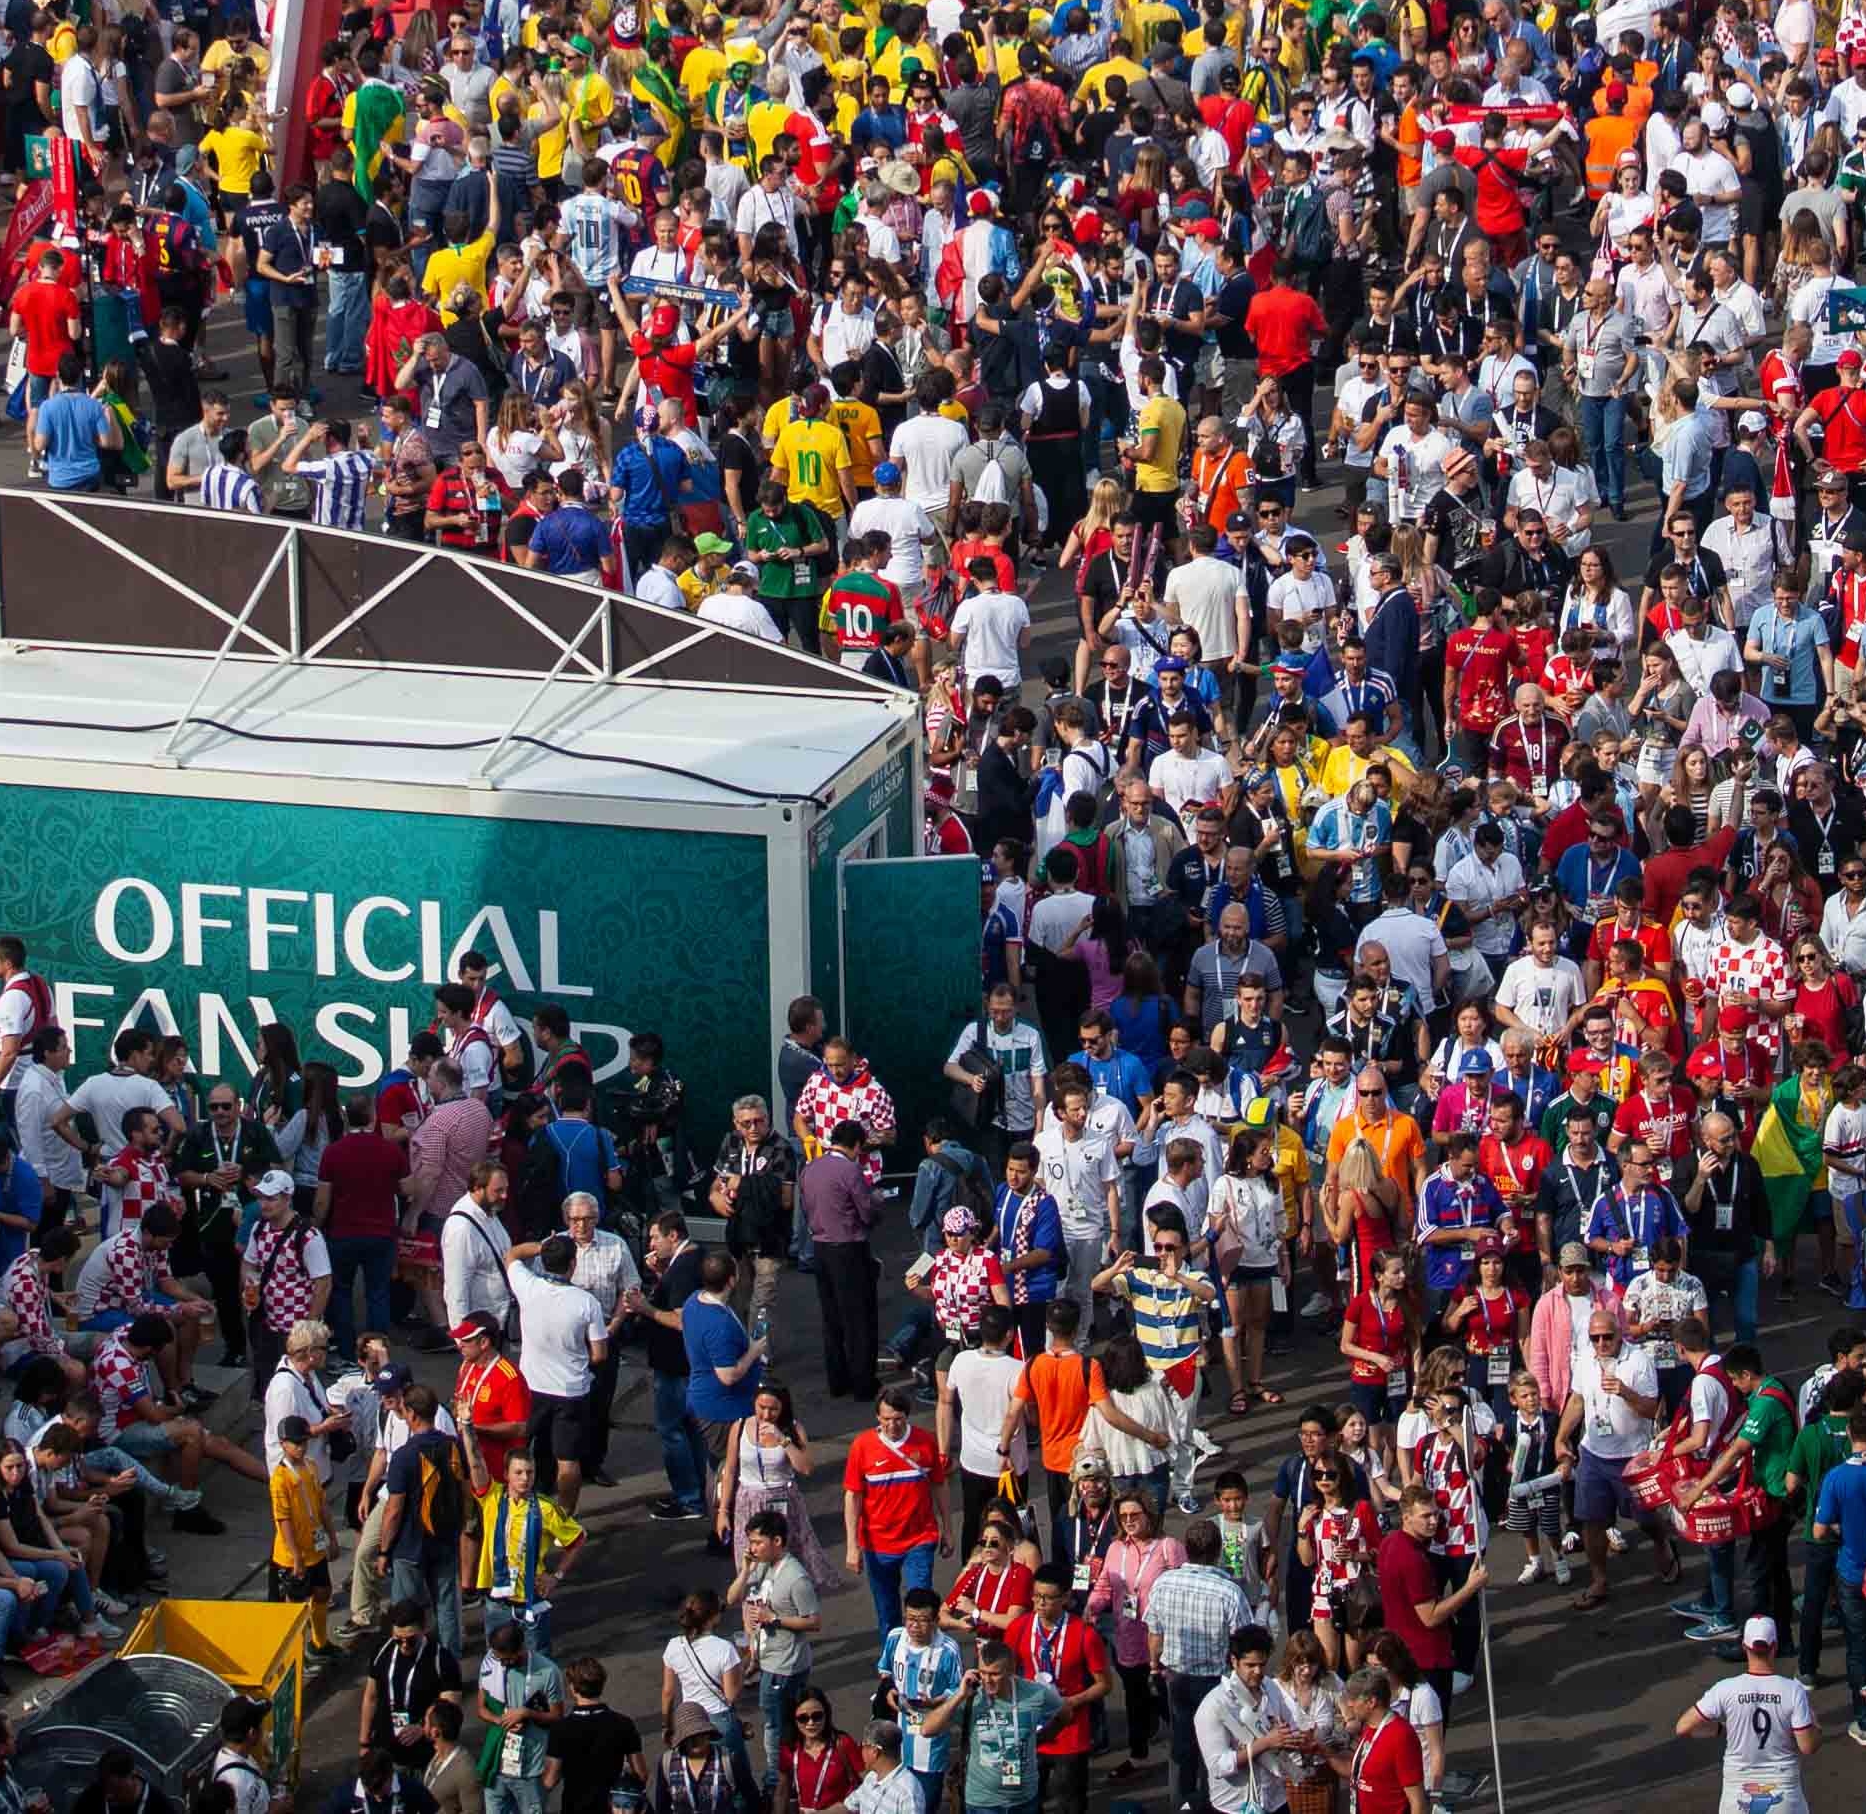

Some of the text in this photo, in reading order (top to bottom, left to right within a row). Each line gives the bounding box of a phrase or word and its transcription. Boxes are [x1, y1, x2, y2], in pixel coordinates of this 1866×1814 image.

[618, 172, 642, 205] 10
[577, 219, 600, 249] 10
[797, 449, 821, 487] 10
[841, 601, 873, 638] 10
[1455, 642, 1502, 656] Volunteer
[94, 876, 594, 998] OFFICIAL
[54, 982, 281, 1083] FAN
[1738, 1693, 1782, 1706] GUERRERO
[1753, 1707, 1771, 1750] 9
